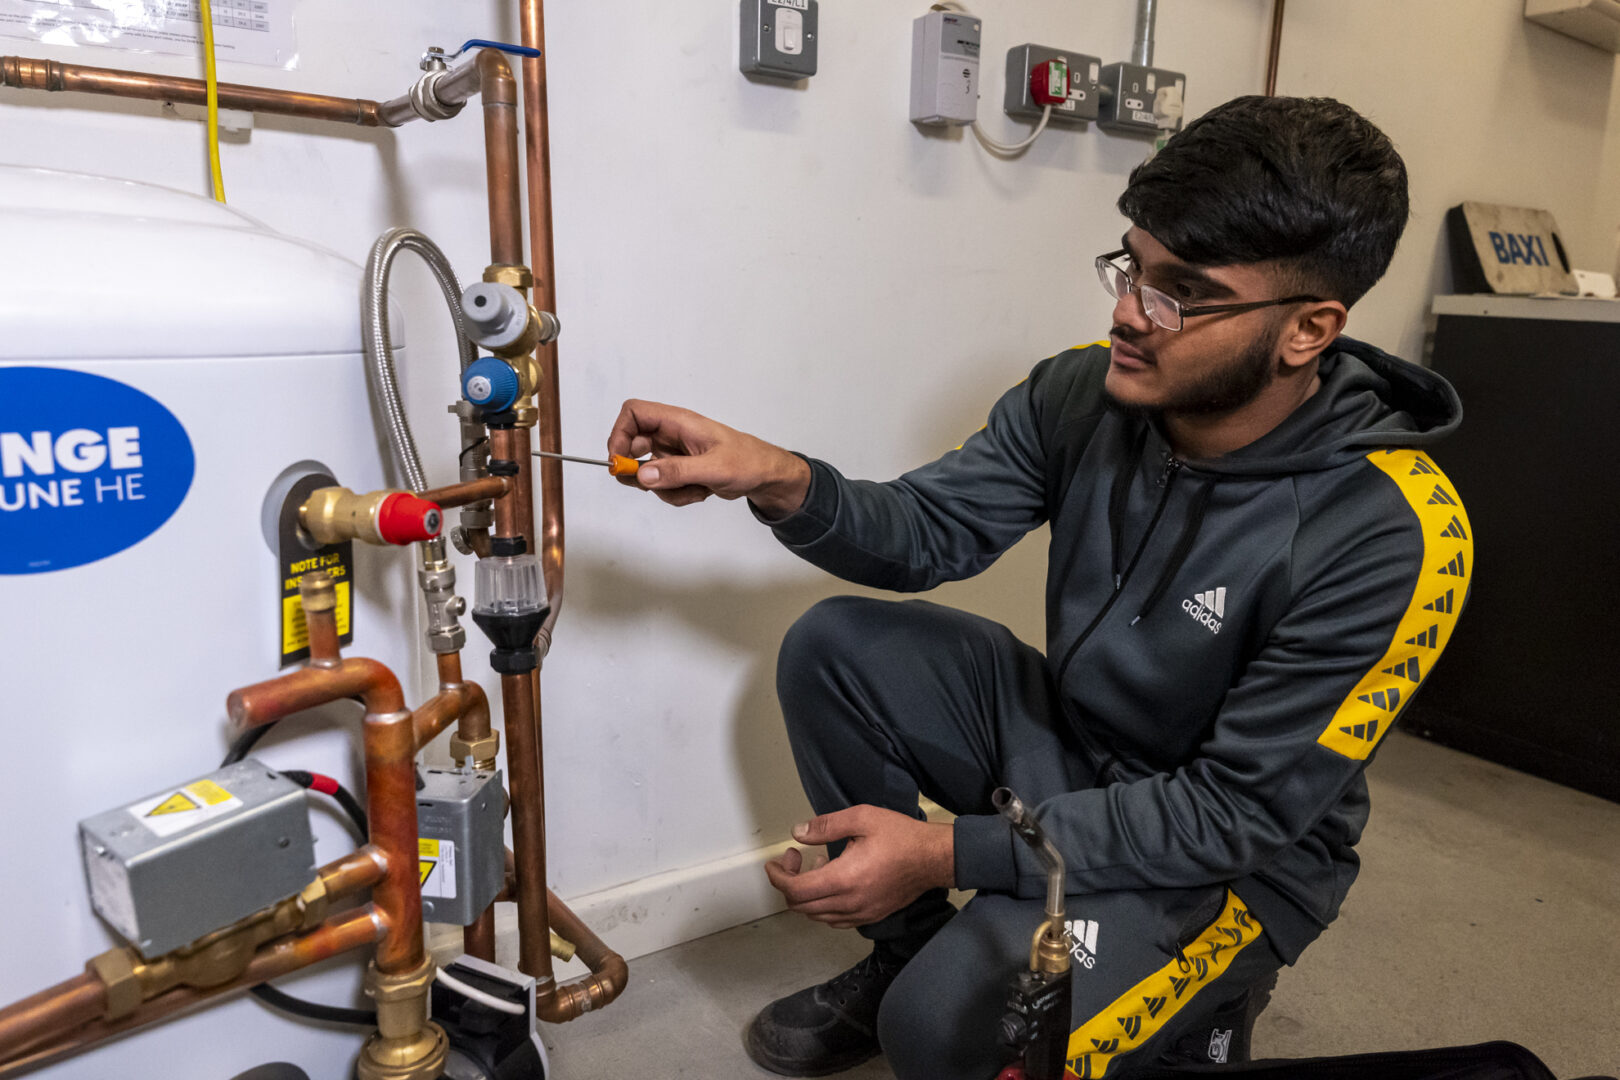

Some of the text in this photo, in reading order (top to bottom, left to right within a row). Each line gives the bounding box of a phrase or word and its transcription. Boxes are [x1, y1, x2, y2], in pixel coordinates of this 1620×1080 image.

[1488, 231, 1549, 267] BAXI
[0, 426, 143, 478] NGE
[95, 473, 146, 503] HE
[284, 565, 346, 590] INSERS
[290, 557, 318, 574] NOTE
[1182, 599, 1222, 635] adidas
